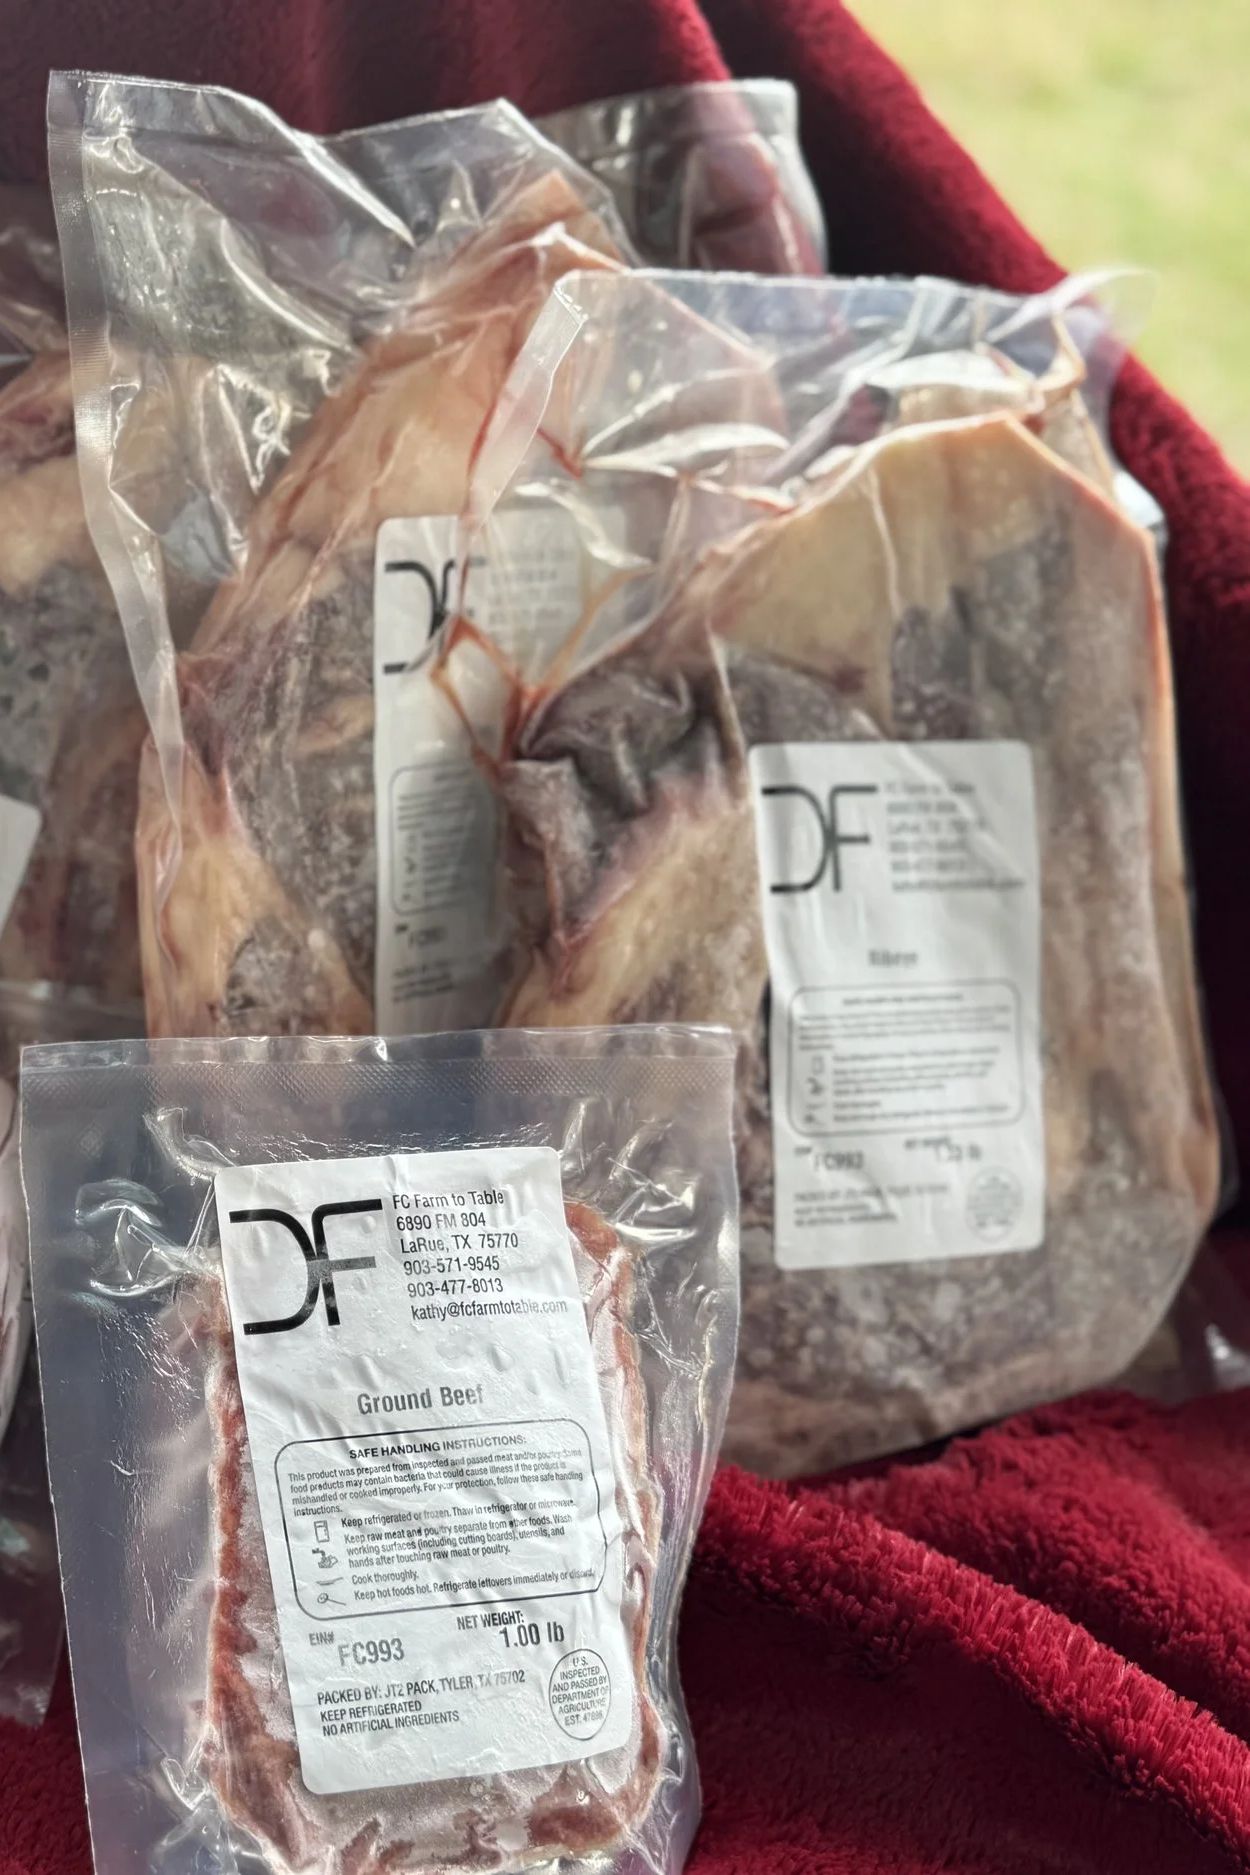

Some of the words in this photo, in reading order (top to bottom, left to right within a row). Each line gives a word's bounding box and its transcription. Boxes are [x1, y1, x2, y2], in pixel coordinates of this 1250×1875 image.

[392, 1194, 411, 1209] FC
[414, 1193, 449, 1208] Farm
[451, 1193, 466, 1207] to
[468, 1189, 504, 1205] Table
[396, 1215, 432, 1232] 6890
[435, 1213, 457, 1230] FM
[460, 1212, 486, 1228] 804
[400, 1237, 450, 1254] LaRue,
[451, 1234, 472, 1250] TX
[478, 1232, 519, 1249] 75770
[403, 1255, 500, 1276] 903-571-9545
[407, 1277, 504, 1298] 903-477-8013
[411, 1298, 568, 1321] kathy@fcfarmtotable.com
[357, 1388, 432, 1415] Ground
[440, 1383, 483, 1407] Beef
[350, 1447, 378, 1459] SAFE
[381, 1441, 440, 1457] HANDLING
[443, 1435, 527, 1451] INSTRUCTIONS:
[289, 1472, 305, 1482] This
[307, 1468, 338, 1480] product
[339, 1468, 355, 1476] was
[356, 1463, 391, 1476] prepared
[392, 1462, 411, 1471] from
[412, 1457, 449, 1470] inspected
[450, 1456, 465, 1466] and
[466, 1454, 492, 1466] passed
[494, 1452, 513, 1461] meat
[290, 1484, 308, 1493] food
[310, 1480, 344, 1492] products
[346, 1479, 363, 1488] may
[364, 1475, 392, 1485] contain
[394, 1471, 425, 1482] bacteria
[427, 1469, 442, 1479] that
[443, 1468, 464, 1478] could
[466, 1466, 488, 1477] cause
[490, 1464, 513, 1474] illness
[520, 1462, 532, 1471] the
[533, 1460, 559, 1472] product
[292, 1493, 338, 1505] mishandled
[339, 1491, 348, 1499] or
[349, 1487, 378, 1499] cooked
[379, 1483, 423, 1497] improperly.
[424, 1482, 436, 1492] For
[455, 1475, 496, 1490] protection,
[497, 1474, 519, 1485] follow
[520, 1473, 538, 1483] these
[539, 1472, 554, 1481] safe
[555, 1470, 583, 1482] handling
[293, 1504, 343, 1517] instructions.
[341, 1517, 363, 1528] Keep
[364, 1511, 412, 1526] refrigerated
[413, 1511, 422, 1521] or
[423, 1508, 451, 1520] frozen.
[452, 1506, 474, 1516] Thaw
[475, 1505, 483, 1514] in
[484, 1501, 527, 1514] refrigerator
[529, 1501, 537, 1510] or
[344, 1534, 366, 1544] Keep
[367, 1532, 383, 1541] raw
[384, 1530, 405, 1540] meat
[406, 1527, 422, 1537] and
[453, 1520, 487, 1533] separate
[489, 1519, 507, 1530] from
[553, 1513, 573, 1524] Wash
[347, 1543, 380, 1556] working
[382, 1540, 417, 1553] surfaces
[418, 1536, 457, 1551] (including
[459, 1532, 486, 1545] cutting
[551, 1526, 565, 1536] and
[349, 1557, 374, 1568] hands
[375, 1555, 394, 1565] after
[396, 1551, 431, 1564] touching
[432, 1549, 448, 1559] raw
[450, 1547, 471, 1558] meat
[472, 1548, 480, 1556] or
[481, 1543, 511, 1557] poultry.
[351, 1573, 373, 1585] Cook
[374, 1569, 419, 1583] thoroughly.
[354, 1590, 376, 1601] Keep
[377, 1586, 391, 1598] hot
[392, 1584, 415, 1597] foods
[433, 1579, 477, 1592] Refrigerate
[478, 1575, 512, 1588] leftovers
[513, 1571, 559, 1585] immediately
[560, 1571, 568, 1580] or
[457, 1614, 478, 1631] NET
[482, 1610, 525, 1629] WEIGHT:
[500, 1622, 541, 1648] 1.00
[337, 1637, 405, 1667] FC993
[552, 1681, 569, 1693] AND
[570, 1677, 598, 1690] PASSED
[598, 1675, 607, 1685] BY
[560, 1665, 600, 1681] INSPECTED
[317, 1687, 362, 1705] PACKED
[364, 1685, 382, 1700] BY:
[384, 1683, 405, 1698] JT2
[406, 1678, 439, 1696] PACK,
[477, 1672, 492, 1687] TX
[494, 1669, 526, 1686] 75702
[551, 1687, 600, 1705] DEPARTMENT
[320, 1707, 347, 1723] KEEP
[348, 1700, 422, 1720] REFRIGERATED
[564, 1714, 582, 1727] EST.
[323, 1724, 338, 1737] NO
[339, 1717, 393, 1735] ARTIFICIAL
[394, 1710, 460, 1730] INGREDIENTS
